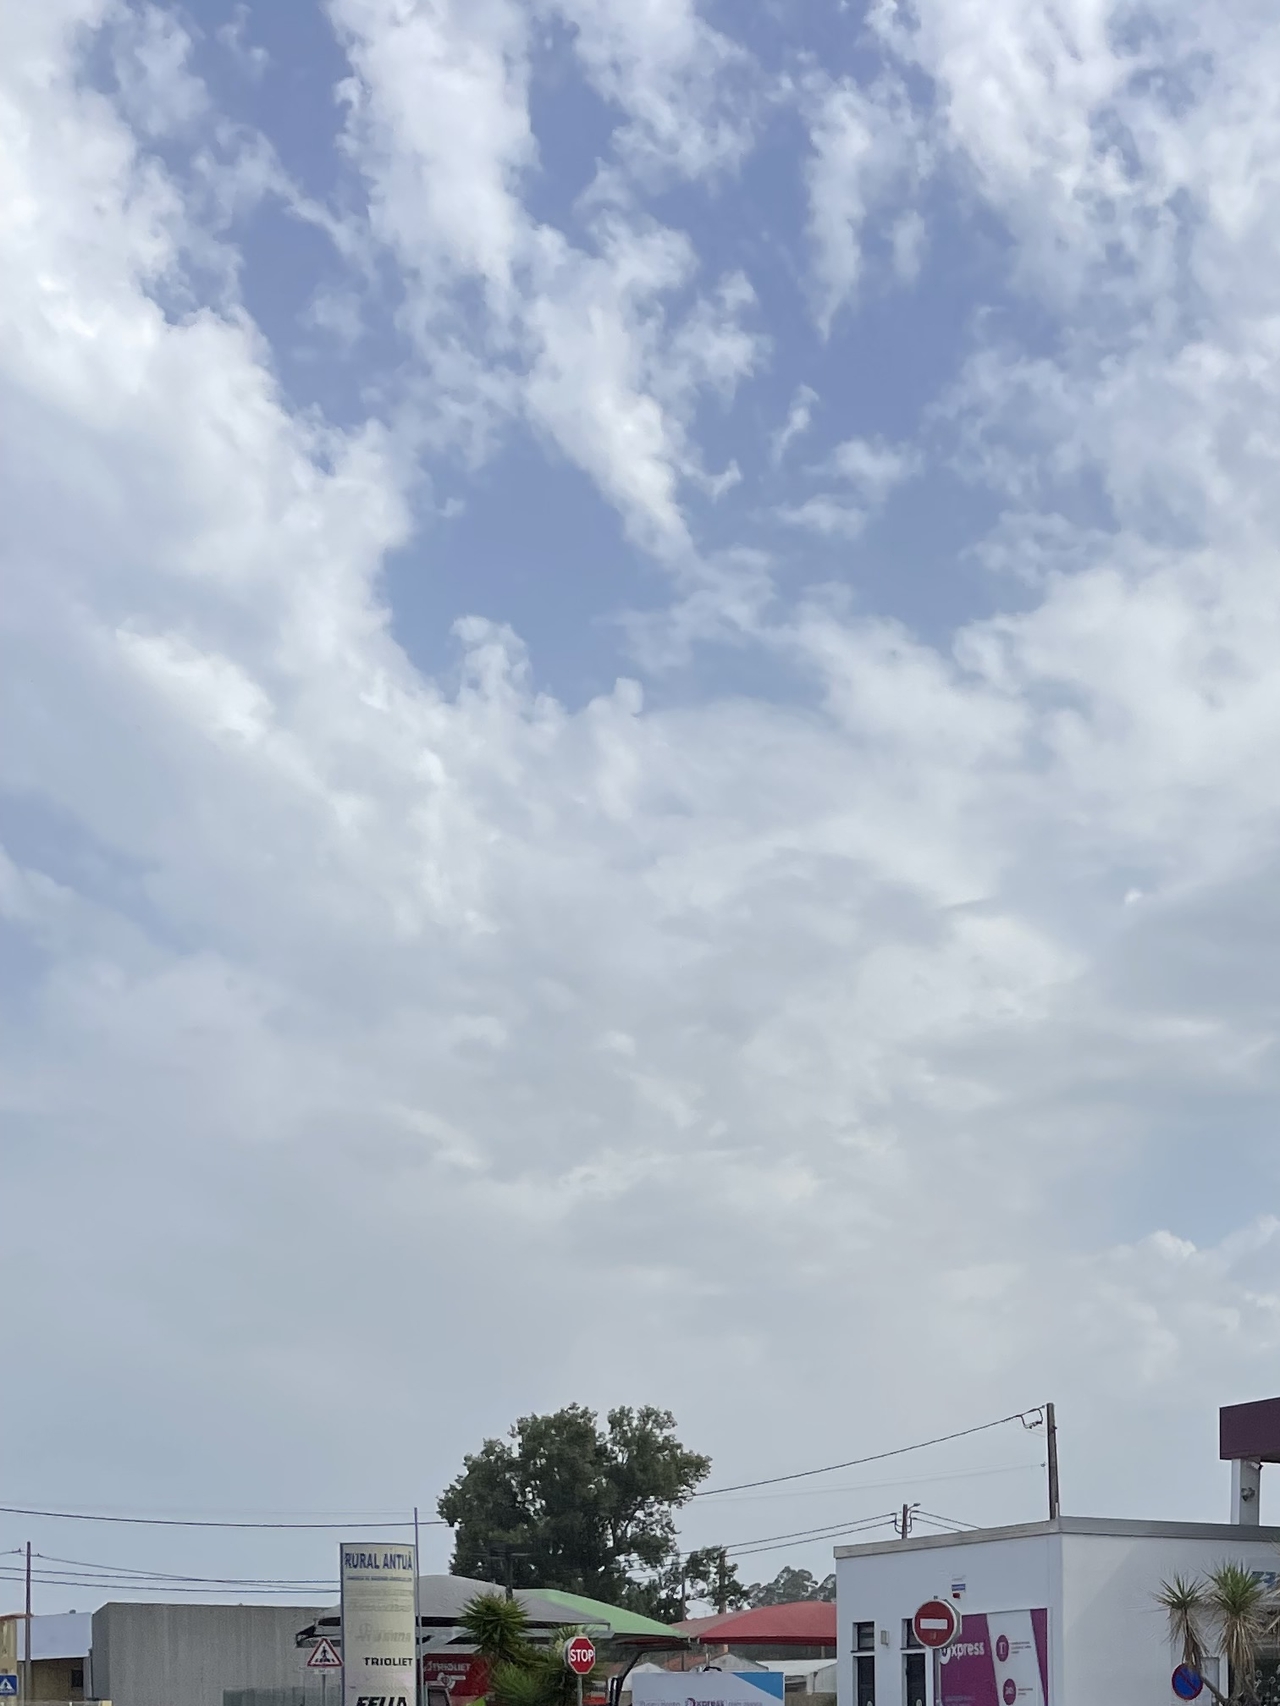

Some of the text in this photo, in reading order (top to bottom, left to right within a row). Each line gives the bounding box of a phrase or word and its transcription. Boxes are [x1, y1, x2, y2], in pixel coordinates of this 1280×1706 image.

[345, 1552, 380, 1570] RURAL
[570, 1649, 594, 1662] STOP
[951, 1641, 985, 1660] xpress
[364, 1657, 413, 1666] TRIOLIET
